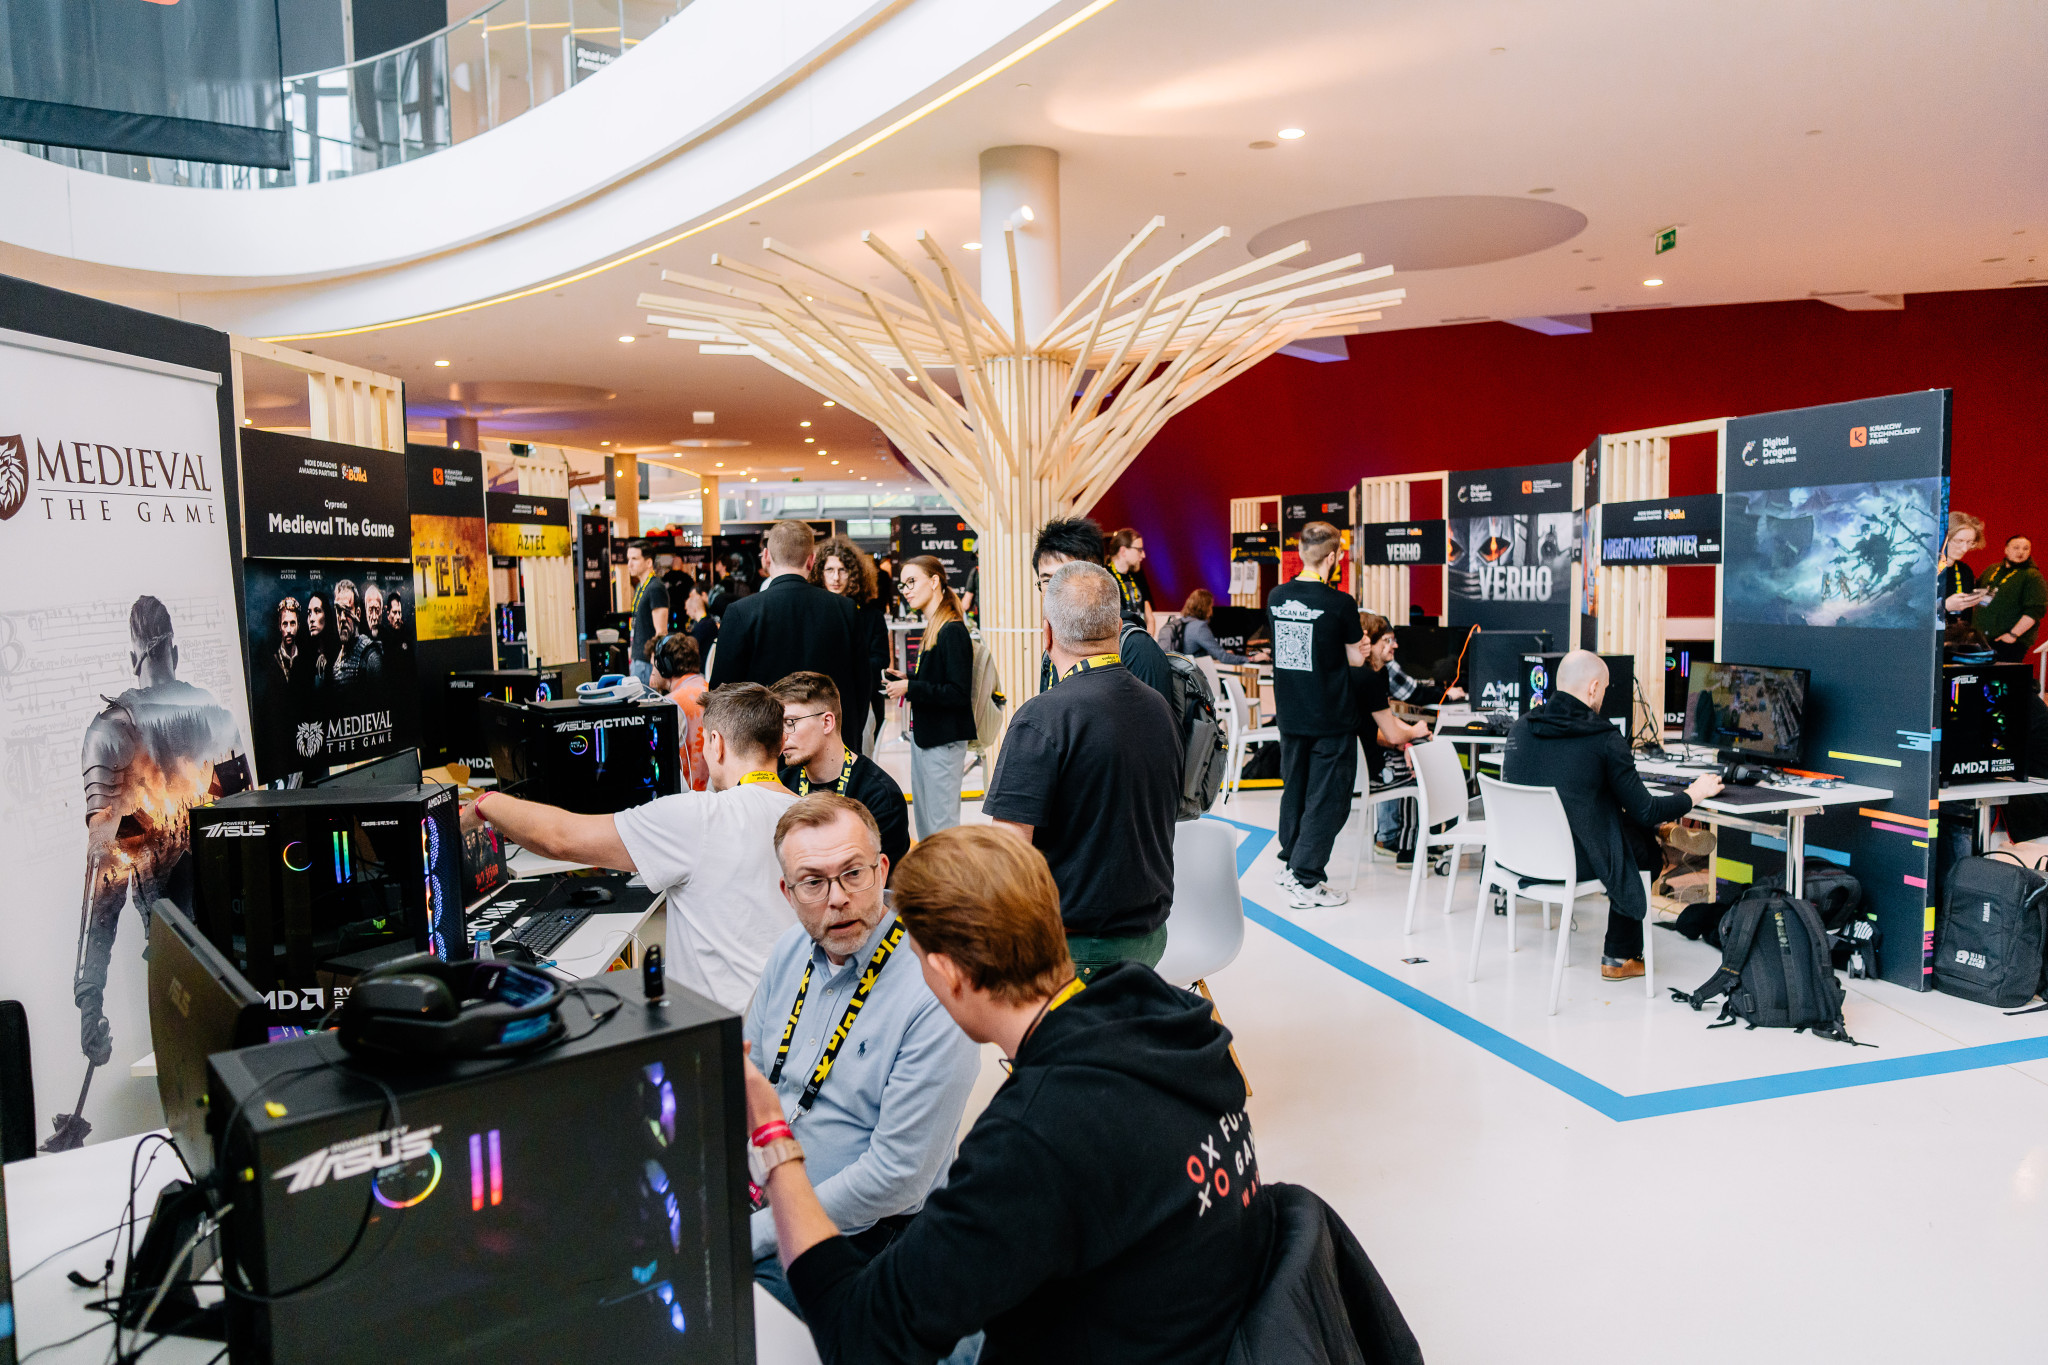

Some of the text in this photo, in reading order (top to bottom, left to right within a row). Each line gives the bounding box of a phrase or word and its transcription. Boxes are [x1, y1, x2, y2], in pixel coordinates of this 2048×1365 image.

[1869, 423, 1902, 432] KRAKOW
[1869, 427, 1921, 438] TECHNOLOGY
[1763, 436, 1789, 449] Digital
[1869, 438, 1889, 446] PARK
[1762, 447, 1797, 458] Dragons
[36, 437, 212, 492] MEDIEVAL
[41, 497, 216, 524] THE GAME
[268, 512, 395, 538] Medieval The Game
[517, 535, 546, 550] AZTEC
[922, 540, 958, 550] LEVEL
[1603, 537, 1657, 560] NIGHTMARE
[1657, 535, 1698, 559] FRONTIER
[1387, 543, 1421, 561] VERHO
[415, 555, 468, 597] TEC
[1479, 565, 1552, 601] VERHO
[1215, 637, 1235, 646] MD
[1482, 682, 1520, 697] AM
[325, 710, 393, 739] MEDIEVAL
[553, 722, 592, 732] ASUS
[327, 732, 392, 754] THE GAME
[459, 758, 484, 769] AMD
[1952, 762, 1979, 775] AMD
[199, 823, 267, 838] ASUS
[334, 987, 352, 997] RY
[272, 1127, 436, 1194] ASUS
